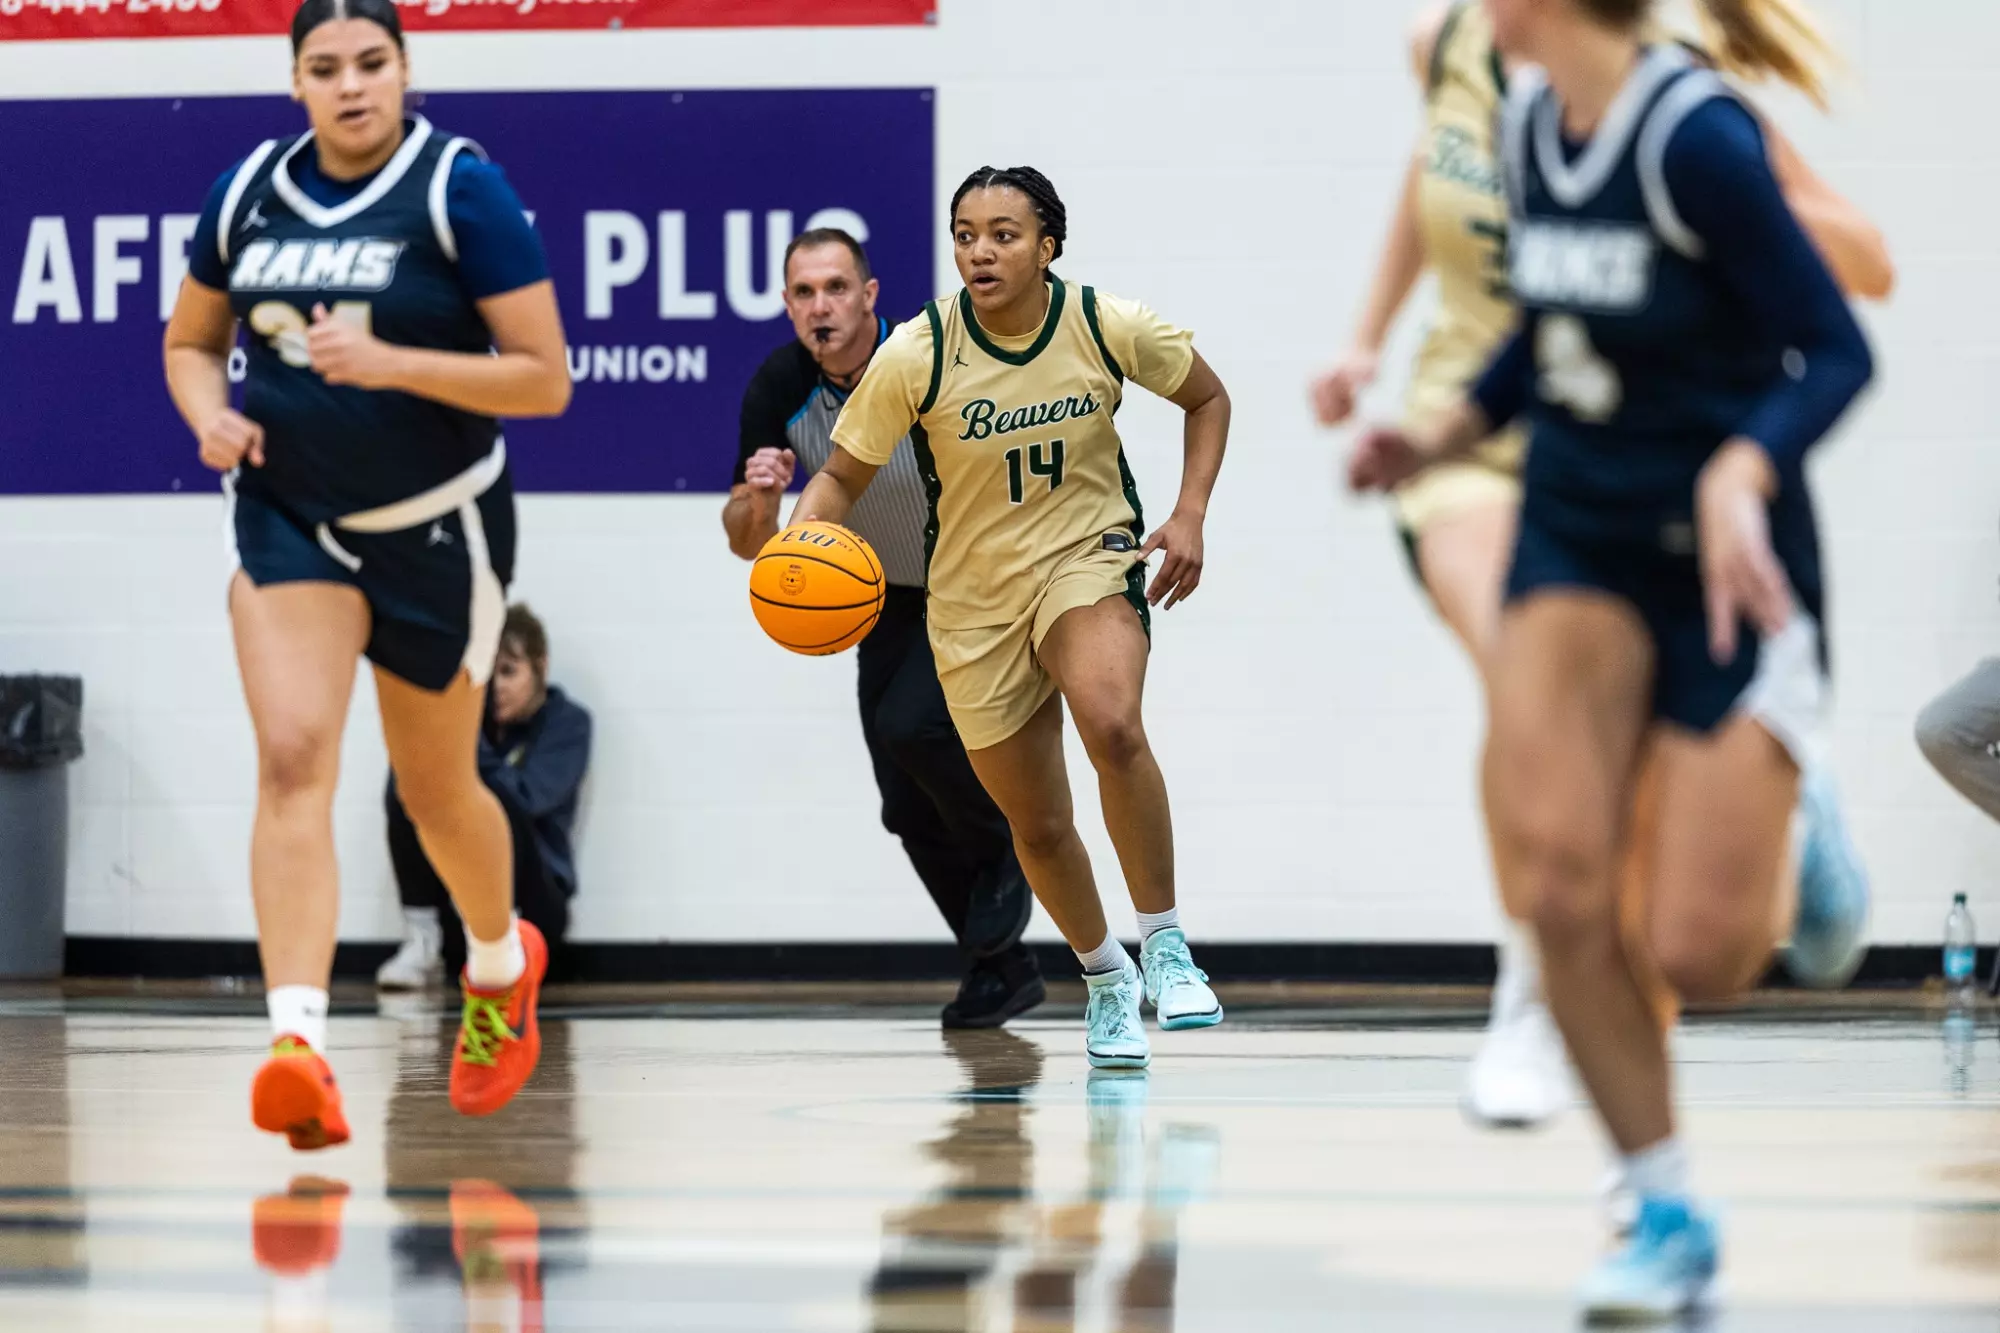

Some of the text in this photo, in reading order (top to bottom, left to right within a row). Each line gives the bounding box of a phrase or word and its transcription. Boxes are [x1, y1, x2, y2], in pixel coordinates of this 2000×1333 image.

[230, 237, 405, 291] RAMS
[585, 208, 869, 321] PLU
[566, 345, 707, 382] UNION
[958, 393, 1101, 441] Beavers
[1004, 438, 1065, 505] 14
